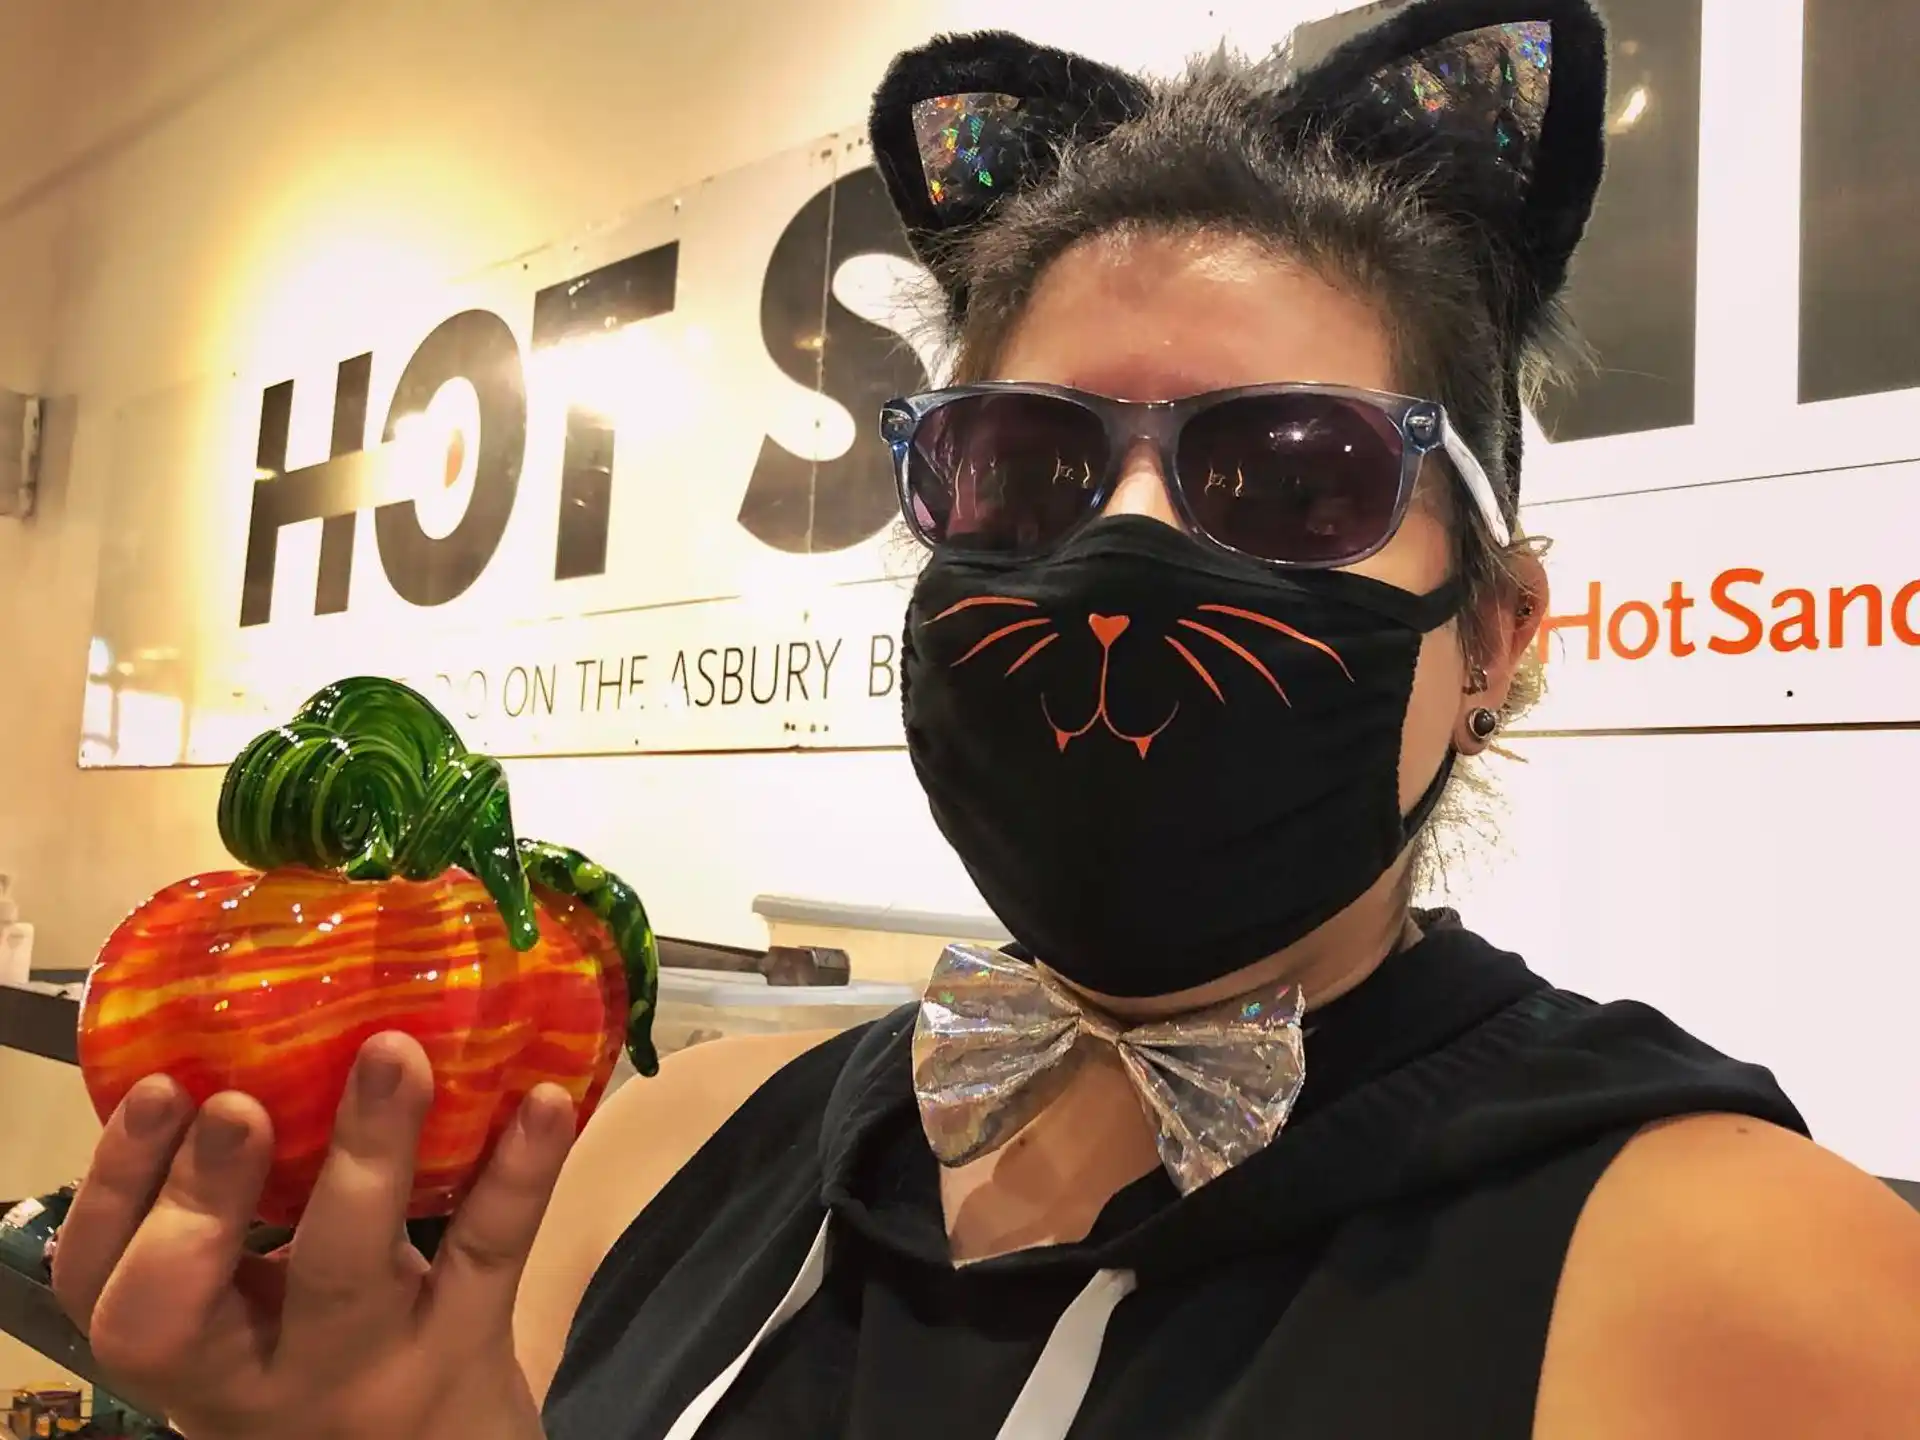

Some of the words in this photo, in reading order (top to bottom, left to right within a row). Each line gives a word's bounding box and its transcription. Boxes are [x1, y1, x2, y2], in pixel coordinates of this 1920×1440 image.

[240, 240, 680, 628] HOT
[737, 164, 929, 555] S
[503, 663, 557, 718] ON
[671, 637, 843, 708] ASBURY
[868, 633, 896, 698] B
